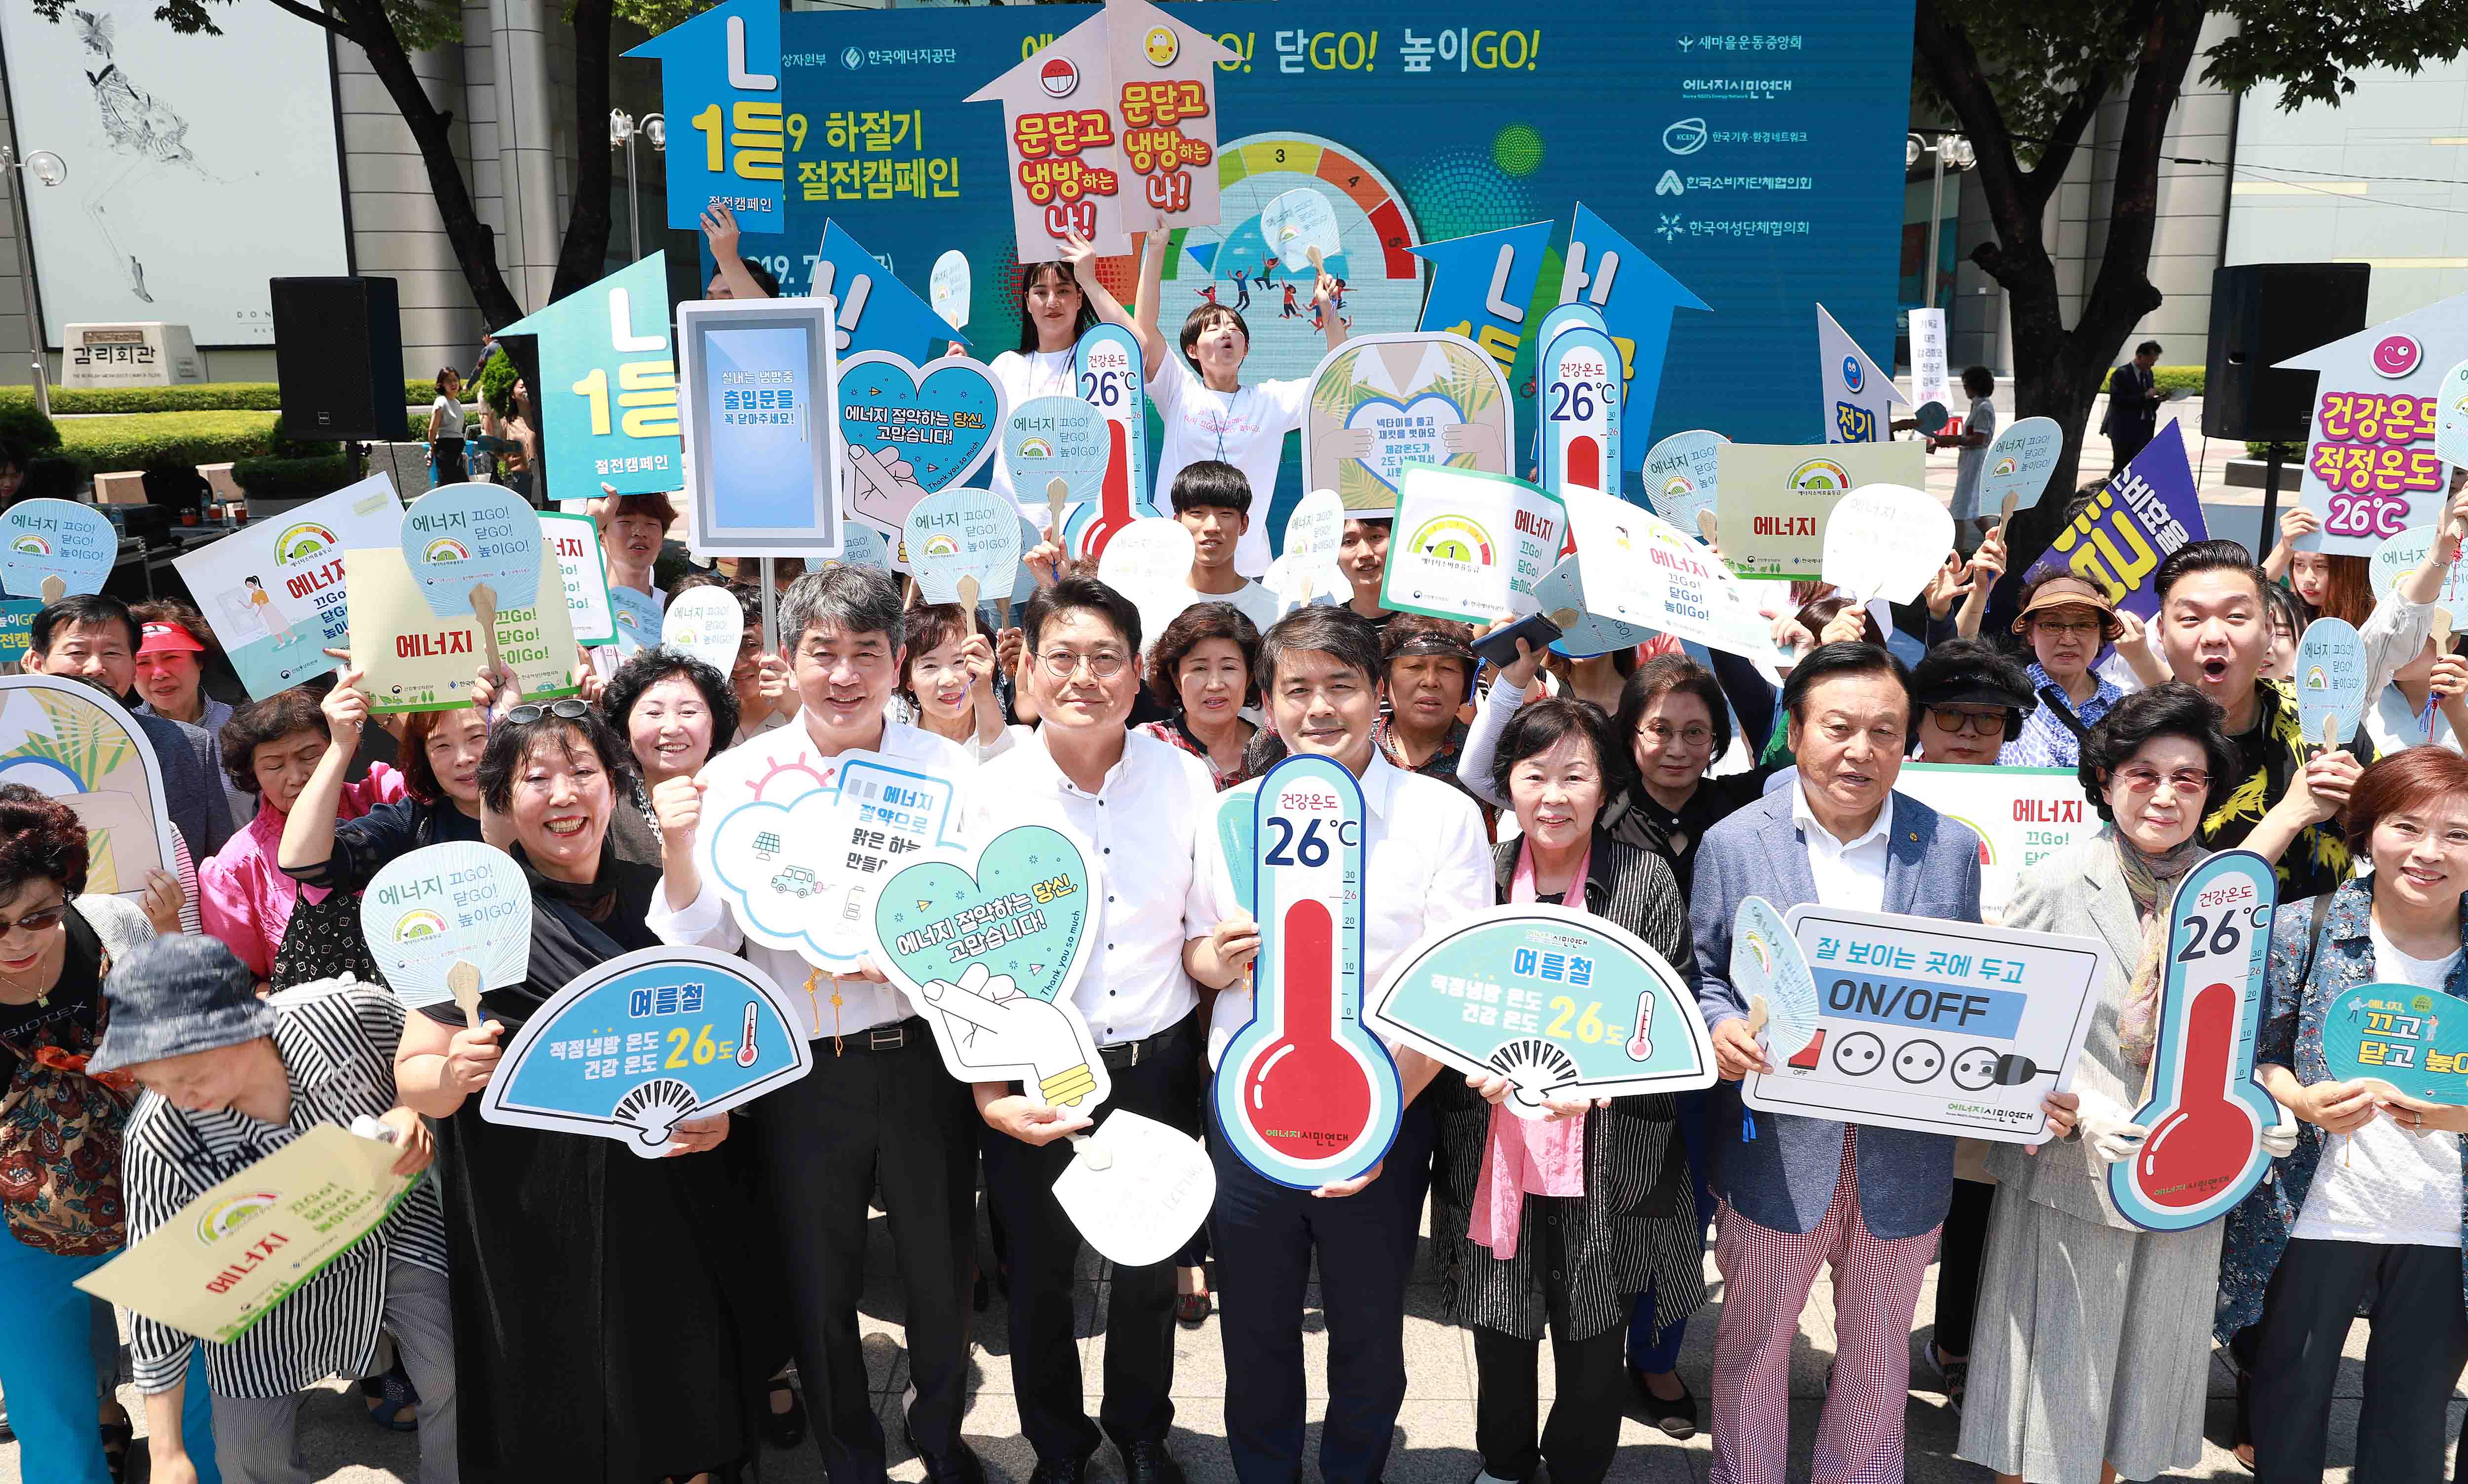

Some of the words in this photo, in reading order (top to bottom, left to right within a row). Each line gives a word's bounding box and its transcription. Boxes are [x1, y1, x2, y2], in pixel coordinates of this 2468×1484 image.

[1275, 29, 1378, 73] 닫GO!
[1400, 28, 1541, 73] 높이GO!
[1698, 35, 1802, 50] 새마을운동중앙회
[782, 53, 826, 67] 상자원부
[867, 49, 956, 65] 한국에너지공단
[1682, 79, 1792, 99] 에너지시민연대
[1121, 81, 1207, 125] 문닫고
[825, 111, 922, 152] 하절기
[1016, 112, 1112, 156] 문닫고
[1125, 128, 1210, 172] 냉방하는
[1275, 149, 1286, 163] 3
[797, 158, 960, 201] 절전캠페인
[1021, 159, 1116, 201] 냉방하는
[1348, 175, 1360, 188] 4
[1687, 177, 1812, 190] 한국소비자단체협의회
[1147, 173, 1190, 211] 나!
[1046, 203, 1093, 237] 나!
[1689, 221, 1810, 236] 한국여성단체협의회
[73, 345, 156, 365] 감리회관
[1088, 354, 1127, 367] 건강온도
[722, 371, 755, 384] 실내는
[1559, 362, 1605, 378] 건강온도
[723, 389, 794, 410] 출입문을
[724, 413, 734, 425] 꼭
[737, 412, 795, 425] 닫아주세요!
[845, 406, 889, 423] 에너지
[891, 408, 950, 427] 절약하는
[952, 411, 987, 429] 당신,
[1013, 417, 1054, 432] 에너지
[1377, 418, 1413, 428] 넥타이를
[1416, 417, 1434, 427] 풀고
[1837, 402, 1875, 442] 전기
[2322, 395, 2437, 440] 건강온도
[876, 425, 954, 445] 고맙습니다!
[1409, 428, 1436, 438] 벗어요
[1060, 446, 1099, 458] 높이GO!
[1385, 443, 1430, 454] 체감온도가
[1996, 438, 2026, 453] 에너지
[595, 455, 669, 475] 절전캠페인
[927, 474, 949, 491] Thank
[946, 462, 960, 480] you
[958, 455, 967, 466] so
[965, 440, 980, 460] much
[1382, 456, 1396, 466] 2도
[1650, 454, 1689, 474] 에너지
[2021, 458, 2051, 472] 높이GO!
[2314, 446, 2437, 491] 적정온도
[1816, 480, 1821, 489] 1
[11, 515, 58, 533] 에너지
[63, 521, 96, 533] 끄GO!
[412, 510, 467, 533] 에너지
[472, 506, 510, 522] 끄GO!
[916, 511, 960, 530] 에너지
[1291, 512, 1313, 530] 에너지
[1514, 509, 1554, 542] 에너지
[1753, 516, 1816, 536] 에너지
[59, 548, 104, 561] 높이GO!
[477, 539, 530, 559] 높이GO!
[967, 537, 1009, 553] 높이GO!
[1449, 545, 1455, 558] 1
[1520, 540, 1542, 560] 끄Go!
[1650, 547, 1709, 579] 에너지
[1666, 572, 1702, 590] 끄Go!
[496, 608, 538, 624] 끄Go!
[674, 605, 704, 619] 에너지
[1664, 600, 1710, 620] 높이Go!
[395, 630, 473, 658] 에너지
[2304, 643, 2331, 658] 에너지
[883, 785, 934, 811] 에너지
[1281, 793, 1338, 810] 건강온도
[859, 804, 928, 835] 절약으로
[2013, 799, 2082, 823] 에너지
[851, 828, 885, 850] 맑은
[2025, 831, 2070, 845] 끄Go!
[379, 875, 443, 905] 에너지
[450, 863, 494, 885] 끄GO!
[1345, 871, 1355, 879] 30
[1345, 890, 1357, 900] 26
[2198, 885, 2253, 908] 건강온도
[458, 900, 518, 928] 높이GO!
[895, 917, 956, 956] 에너지
[953, 893, 1033, 935] 절약하는
[1031, 873, 1078, 904] 당신,
[1345, 916, 1355, 925] 20
[945, 909, 1047, 963] 고맙습니다!
[1040, 970, 1062, 996] Thank
[1058, 949, 1070, 969] you
[1066, 937, 1074, 948] so
[1072, 910, 1081, 936] much
[1816, 937, 1841, 960] 잘
[1846, 941, 1916, 970] 보이는
[1925, 951, 1972, 977] 곳에
[1978, 958, 2026, 984] 두고
[1345, 962, 1354, 970] 10
[1513, 947, 1594, 987] 여름철
[2249, 967, 2262, 976] 26
[629, 984, 705, 1019] 여름철
[1431, 974, 1502, 1003] 적정냉방
[1506, 988, 1543, 1011] 온도
[1544, 995, 1624, 1046] 26도
[1829, 979, 1991, 1026] ON/OFF
[1462, 1002, 1499, 1026] 건강
[1503, 1010, 1540, 1034] 온도
[2362, 1011, 2422, 1041] 끄고
[549, 1036, 620, 1062] 적정냉방
[625, 1030, 660, 1053] 온도
[665, 1023, 735, 1070] 26도
[2357, 1039, 2417, 1069] 닫고
[584, 1060, 620, 1080] 건강
[624, 1054, 658, 1075] 온도
[1947, 1103, 2034, 1124] 에너지시민연대
[1266, 1129, 1349, 1147] 에너지시민연대
[206, 1232, 290, 1294] 에너지
